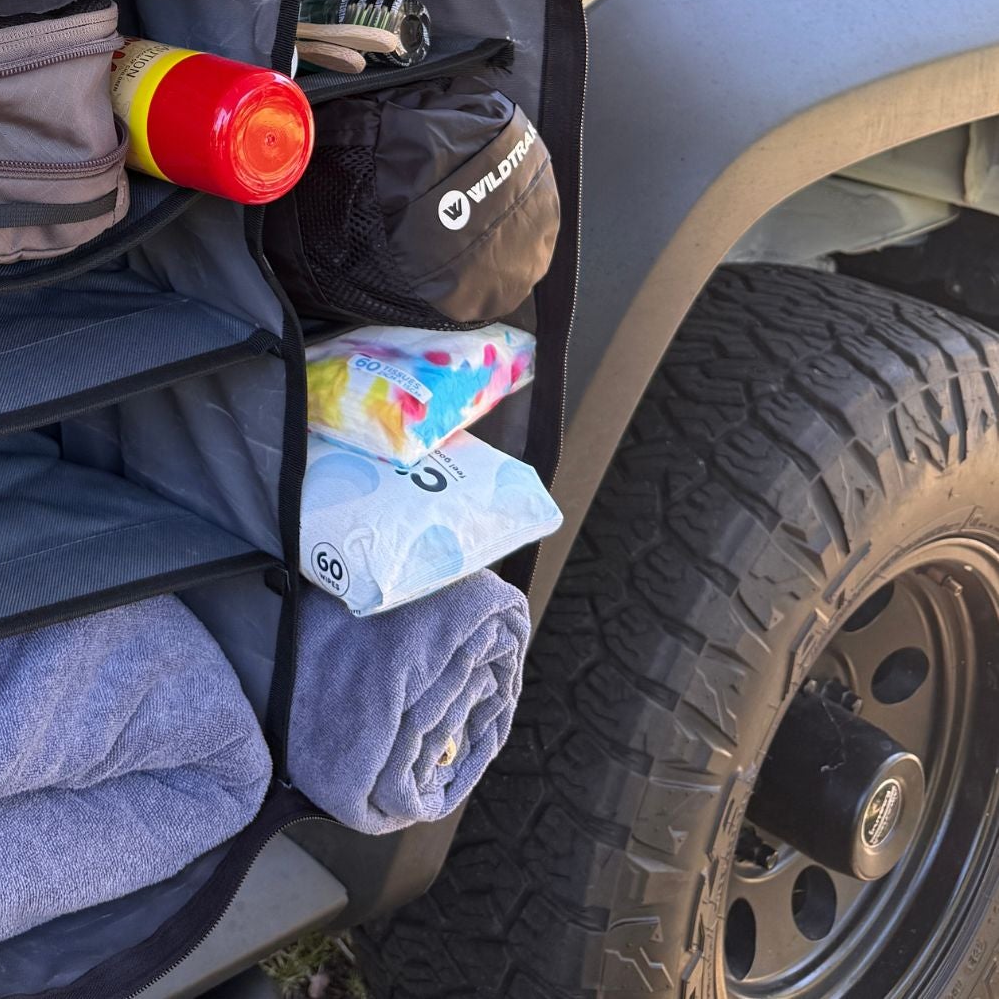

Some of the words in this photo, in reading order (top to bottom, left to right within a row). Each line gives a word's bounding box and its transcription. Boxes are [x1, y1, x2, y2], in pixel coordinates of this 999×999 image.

[355, 357, 381, 372] 60
[383, 365, 422, 390] TISSUES
[434, 449, 452, 463] goo
[449, 463, 467, 480] feel
[317, 551, 343, 581] 60
[319, 572, 340, 591] WIPES
